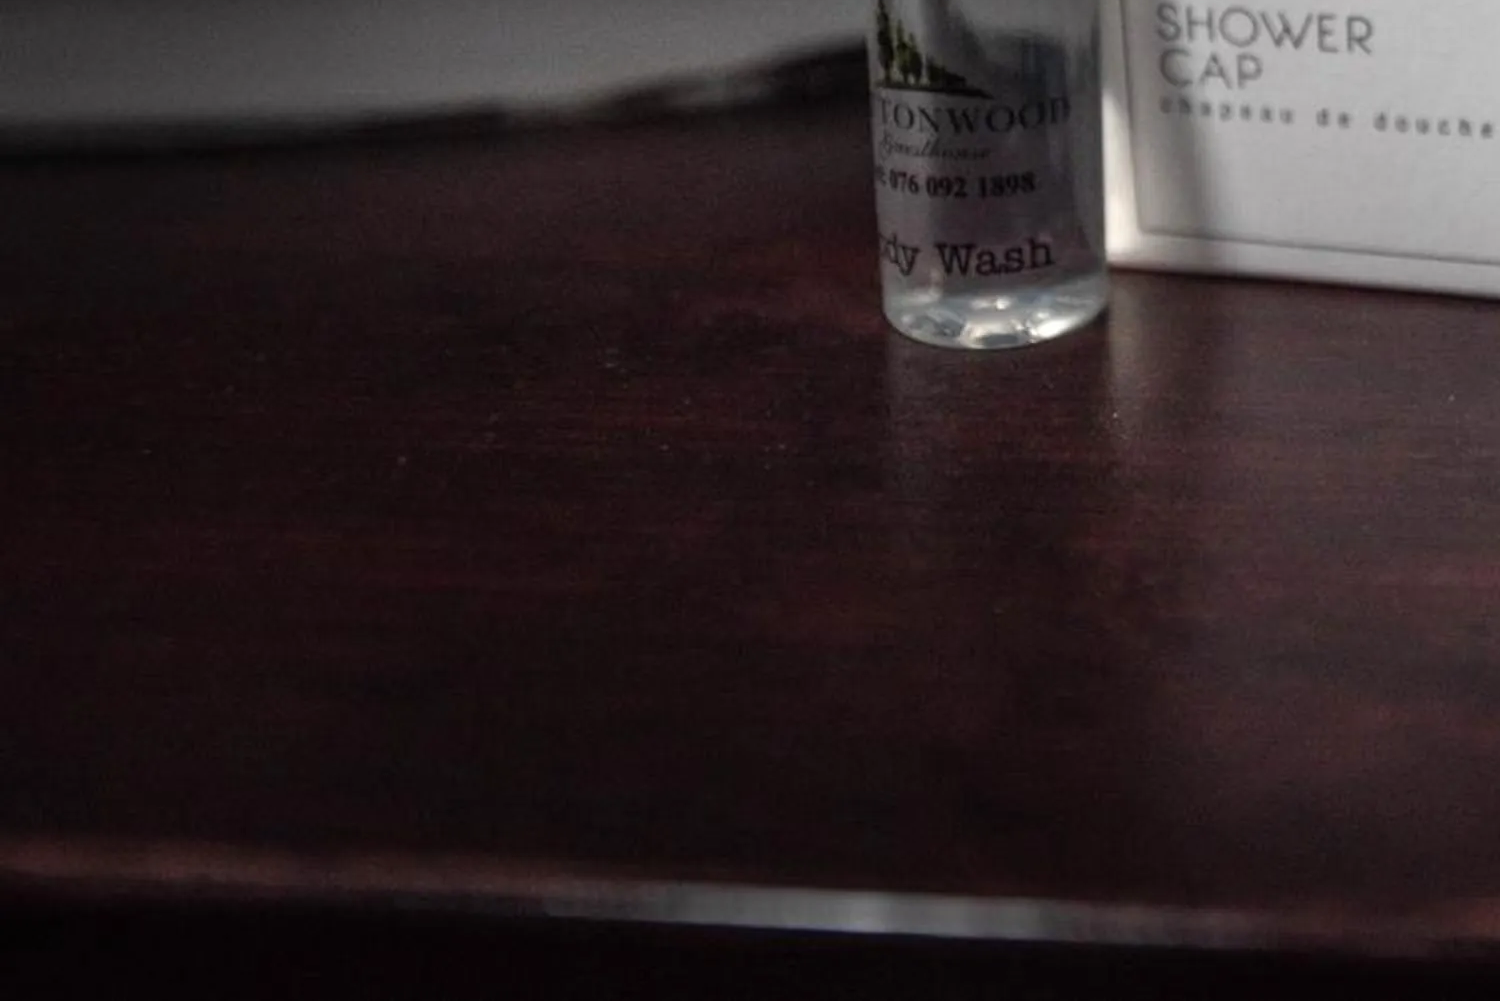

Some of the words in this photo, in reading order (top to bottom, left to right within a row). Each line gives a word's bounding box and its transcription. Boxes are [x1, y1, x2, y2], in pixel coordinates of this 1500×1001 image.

[1155, 2, 1374, 55] SHOWER
[1159, 47, 1264, 89] CAP
[1316, 107, 1351, 130] de
[1373, 110, 1495, 139] douche
[925, 174, 968, 199] 092
[977, 171, 1036, 198] 1898
[934, 236, 1056, 277] Wash
